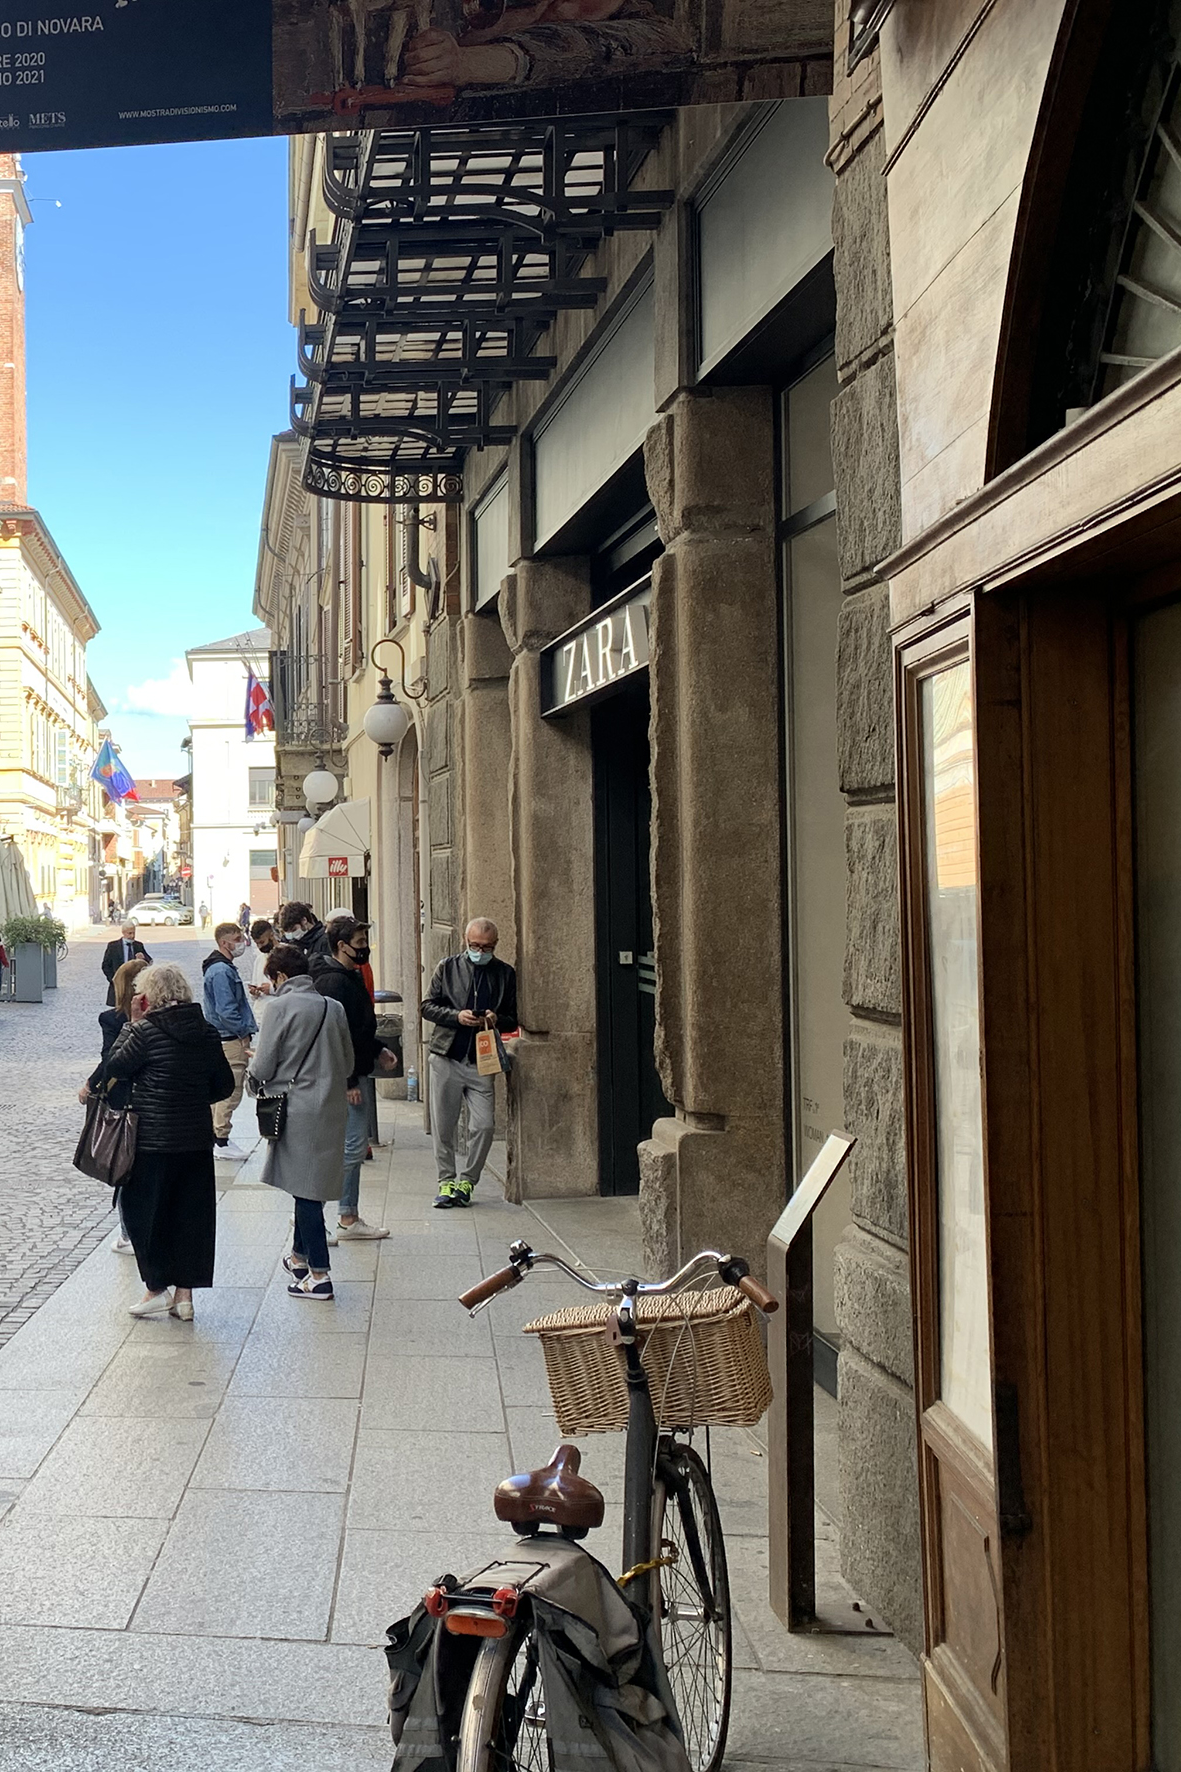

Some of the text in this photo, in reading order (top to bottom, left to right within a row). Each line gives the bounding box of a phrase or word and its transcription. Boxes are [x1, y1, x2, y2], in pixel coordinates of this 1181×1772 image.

[17, 21, 32, 37] DI
[37, 16, 104, 35] NOVARA
[15, 52, 46, 67] 2020
[16, 70, 45, 85] 2021
[29, 112, 66, 125] METS
[118, 104, 237, 119] WWW.MOSTRADIVISIONISMO.COM
[563, 604, 638, 702] ZARA
[330, 859, 347, 875] illy
